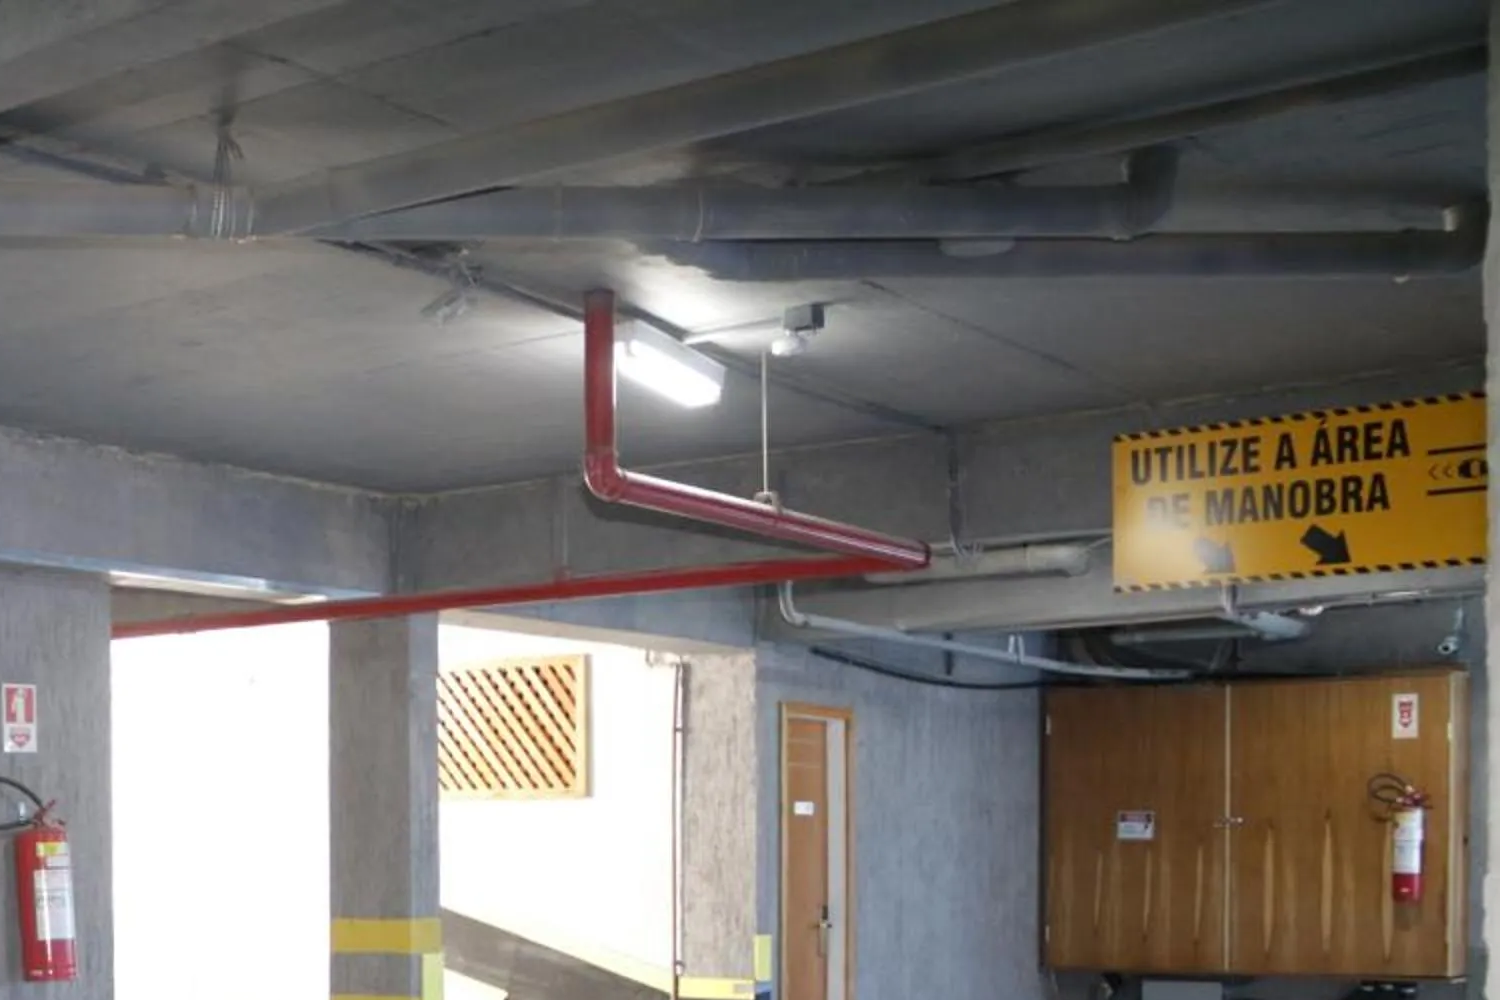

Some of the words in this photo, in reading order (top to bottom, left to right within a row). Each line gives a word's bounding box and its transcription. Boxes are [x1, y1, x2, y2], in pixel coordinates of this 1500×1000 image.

[1131, 435, 1261, 486] UTILIZE
[1274, 431, 1298, 471] A
[1310, 417, 1411, 467] ÁREA
[1145, 491, 1192, 529] DE
[1204, 472, 1391, 527] MANOBRA
